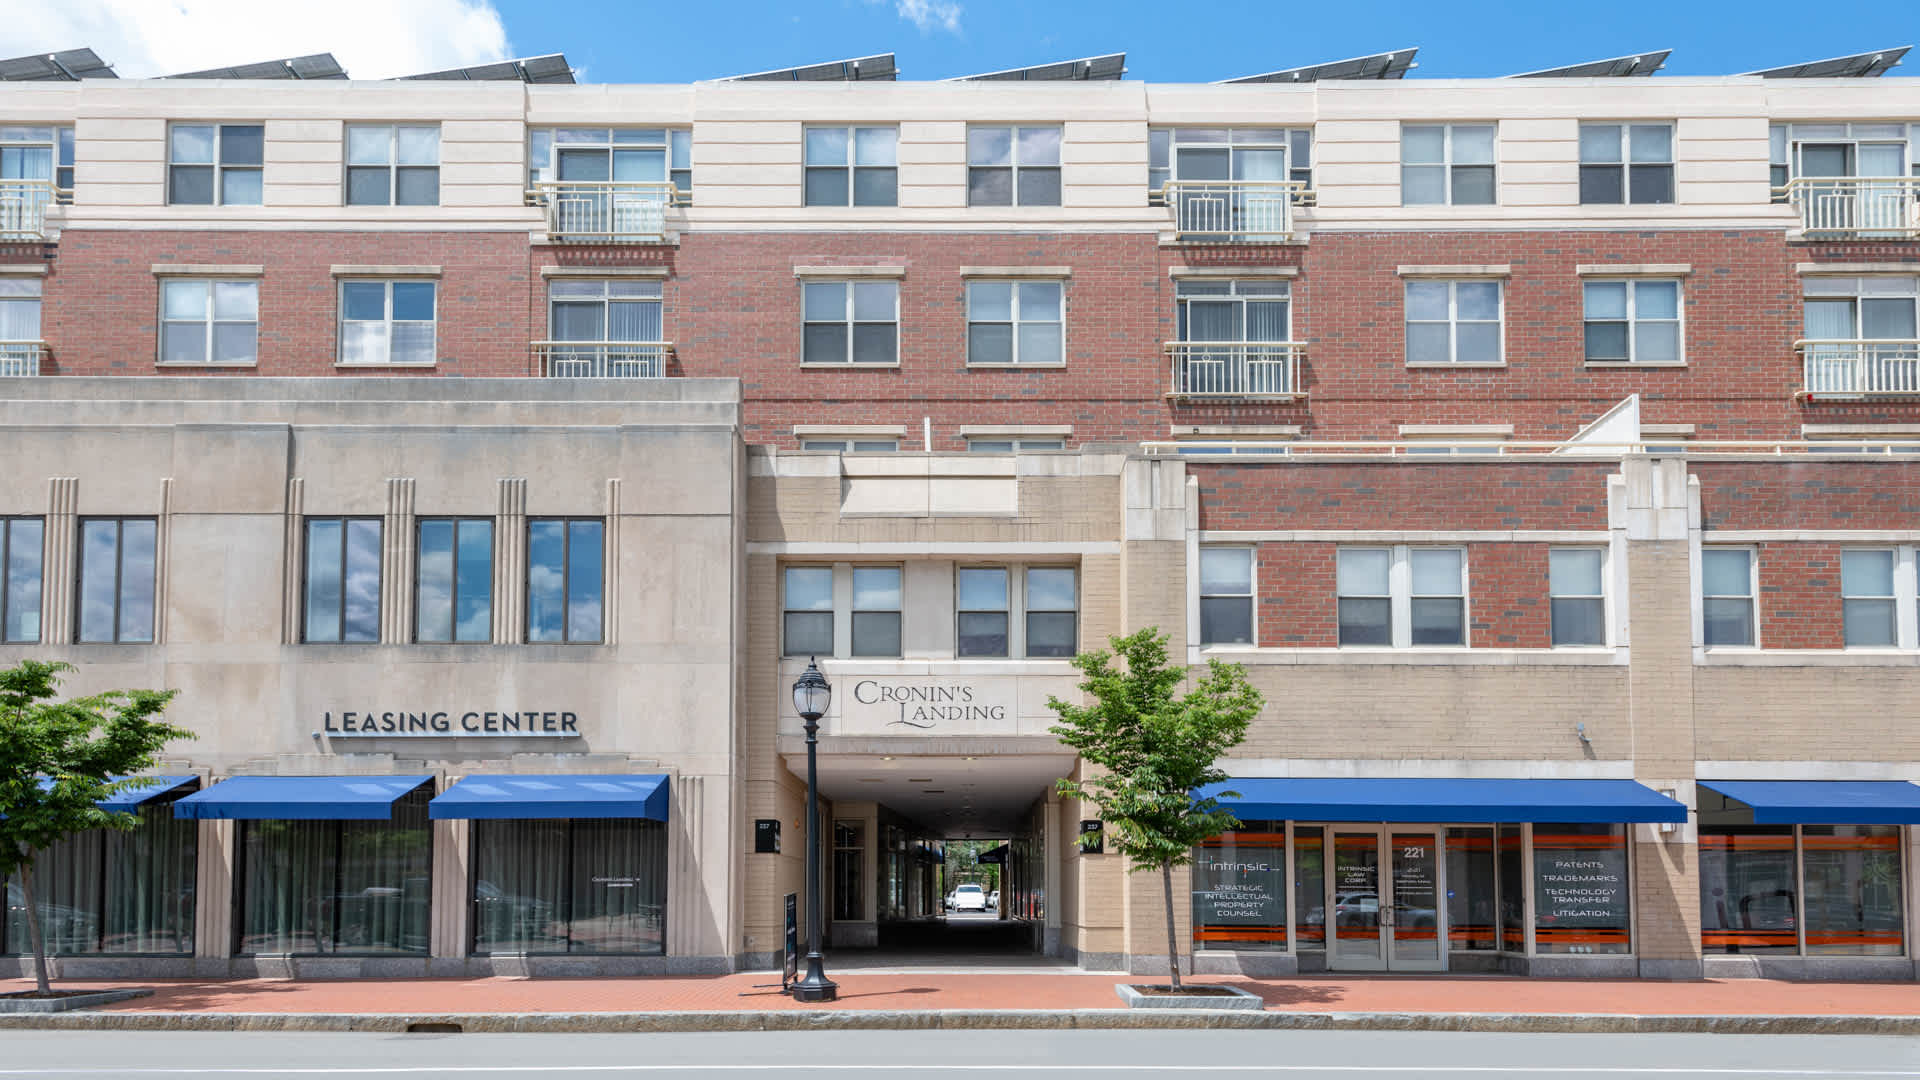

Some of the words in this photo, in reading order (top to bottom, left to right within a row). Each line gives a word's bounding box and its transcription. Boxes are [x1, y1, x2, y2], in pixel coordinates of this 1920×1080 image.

[854, 680, 973, 705] CRONIN'S
[886, 702, 1005, 729] LANDING
[324, 711, 450, 733] LEASING
[460, 711, 578, 733] CENTER
[1404, 847, 1424, 858] 221
[1209, 856, 1271, 873] intrinsic
[1555, 861, 1604, 869] PATENTS
[1543, 874, 1618, 882] TRADEMARKS
[1214, 884, 1263, 892] STRATEGIC
[1545, 888, 1617, 896] TECHNOLOGY
[1552, 896, 1610, 904] TRANSFER
[1214, 901, 1264, 909] PROPERTY
[1216, 910, 1263, 918] COUNSEL
[1552, 909, 1611, 917] LITIGATION
